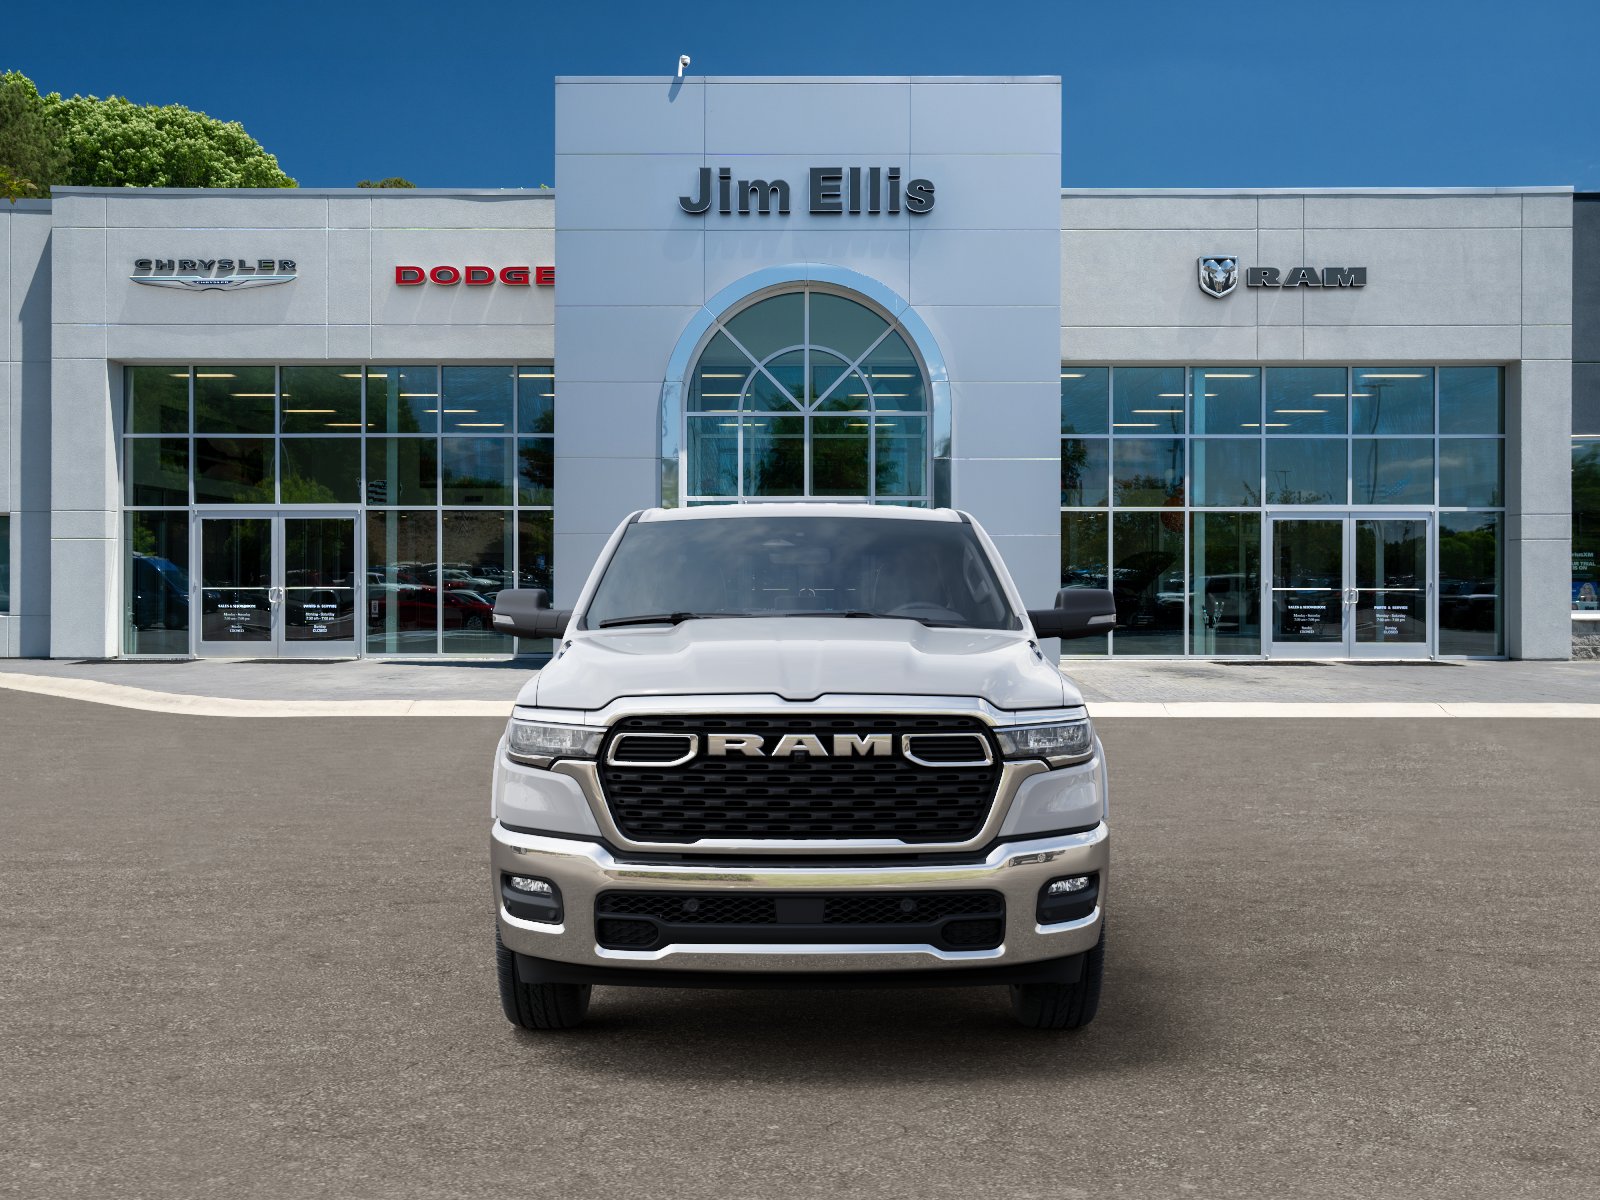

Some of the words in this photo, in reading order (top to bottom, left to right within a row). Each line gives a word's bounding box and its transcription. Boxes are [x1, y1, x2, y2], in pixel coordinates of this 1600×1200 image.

[679, 167, 790, 214] Jim
[808, 167, 935, 214] Ellis
[134, 258, 297, 271] CHRYSLER
[395, 265, 555, 286] DODGE
[1246, 267, 1367, 288] RAM
[707, 733, 892, 757] RAM
